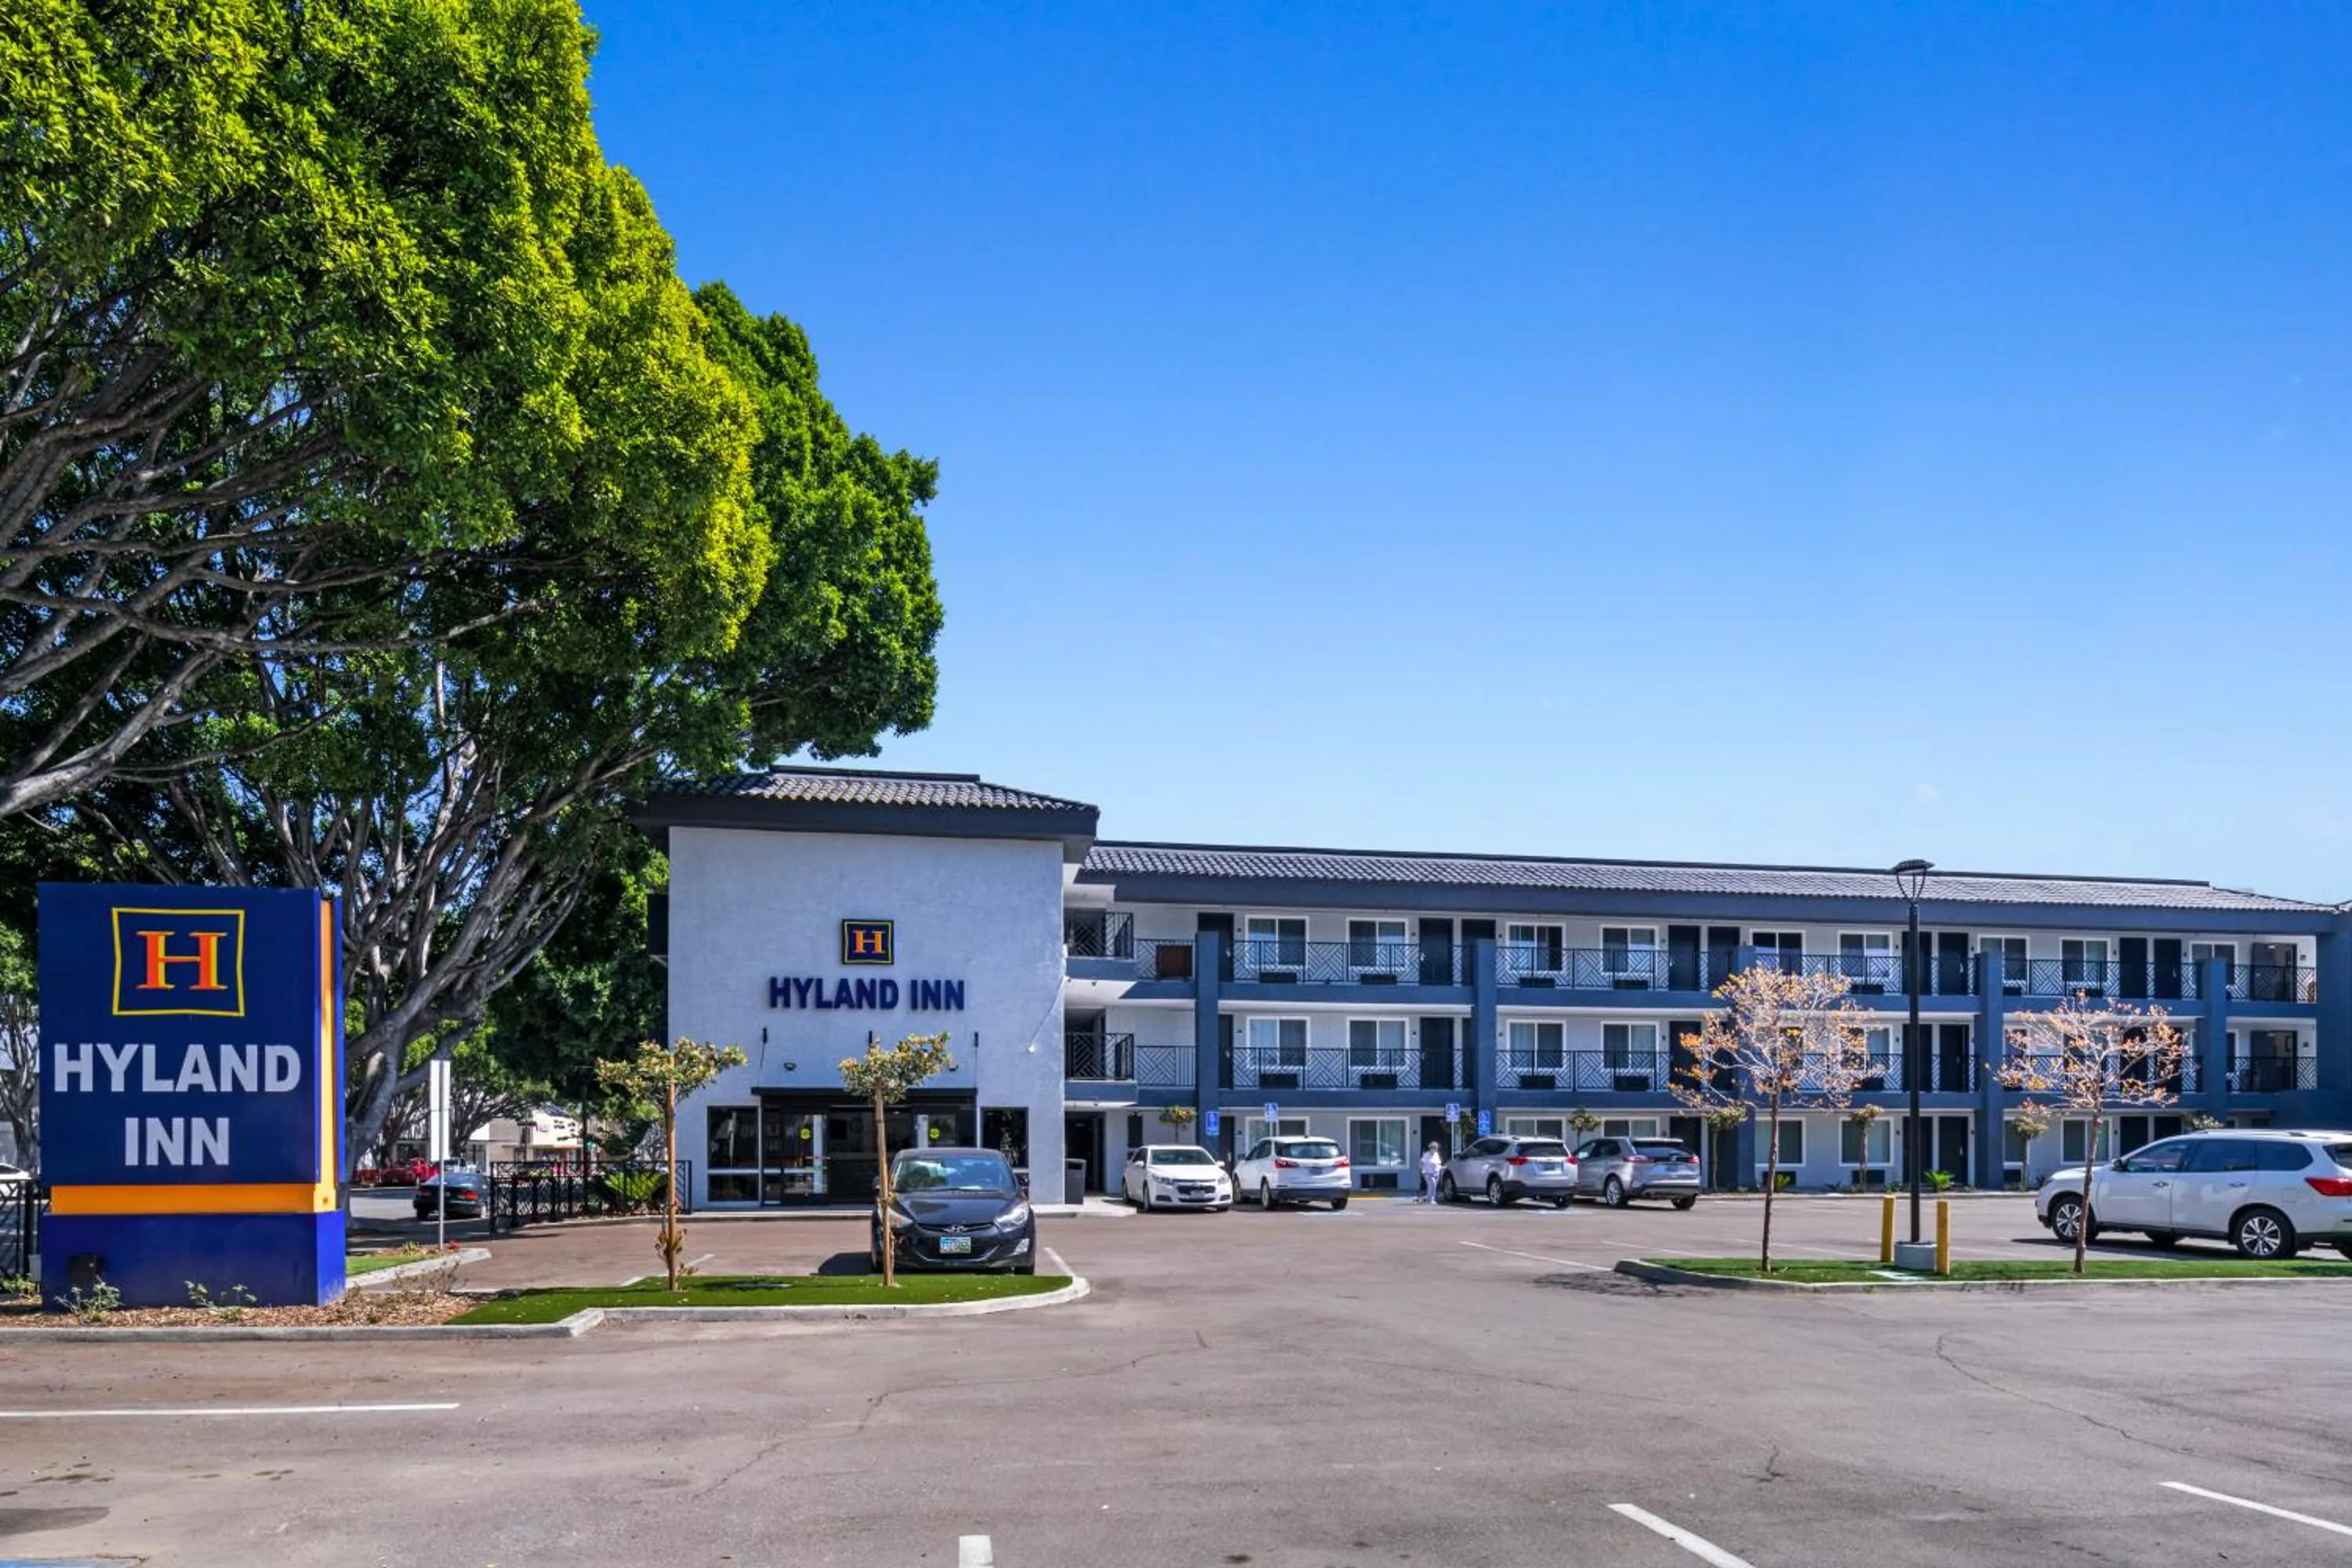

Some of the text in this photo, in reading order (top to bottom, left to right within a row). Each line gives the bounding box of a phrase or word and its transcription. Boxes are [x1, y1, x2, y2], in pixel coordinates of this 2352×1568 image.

[136, 931, 227, 990] H
[852, 930, 885, 953] H
[769, 977, 964, 1011] HYLAND INN
[54, 1044, 302, 1092] HYLAND
[124, 1116, 230, 1166] INN
